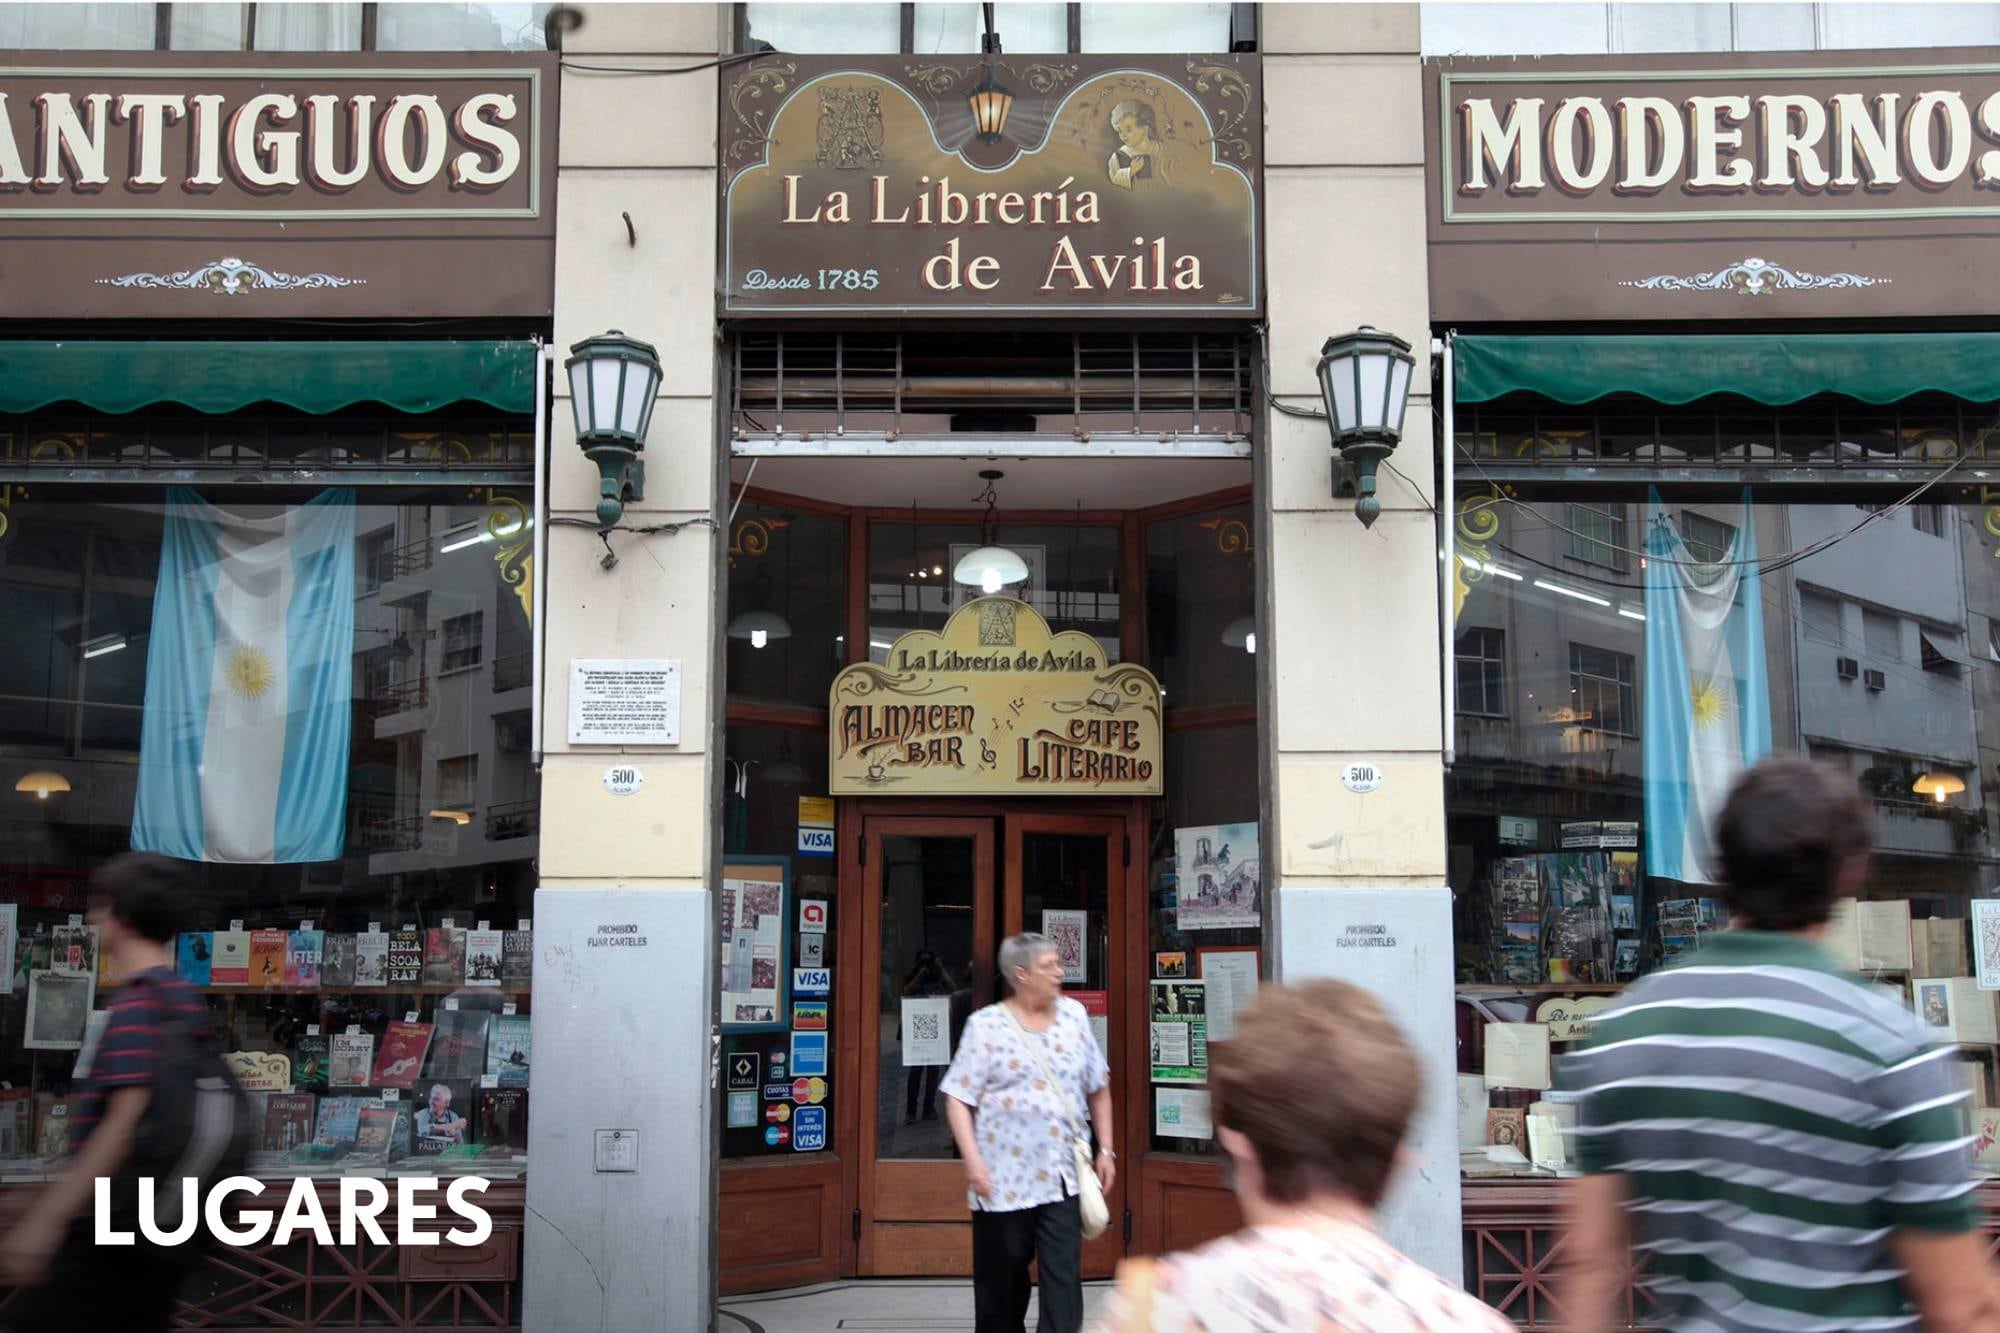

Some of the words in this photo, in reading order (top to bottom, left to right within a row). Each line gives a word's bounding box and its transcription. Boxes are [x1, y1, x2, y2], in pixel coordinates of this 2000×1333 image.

[780, 174, 851, 225] La
[871, 174, 1101, 225] Librería
[922, 236, 1001, 293] de
[1040, 235, 1205, 292] Avila
[741, 268, 812, 291] Desde
[816, 268, 880, 291] 1785
[898, 650, 926, 672] La
[928, 650, 1010, 672] Librería
[1015, 650, 1038, 671] de
[839, 704, 975, 757] ALMACEN
[1040, 718, 1141, 752] CAFE
[890, 736, 966, 767] BAR
[1016, 737, 1153, 785] LITERARIO
[612, 769, 635, 784] 500
[1350, 767, 1374, 781] 500
[802, 832, 832, 847] VISA
[597, 924, 638, 935] PROHIBIDO
[390, 940, 422, 952] BELA
[609, 936, 648, 947] CARTELES
[1358, 936, 1397, 948] CARTELES
[285, 950, 322, 964] AFTER
[808, 945, 820, 955] IC
[389, 955, 421, 966] SCOA
[391, 969, 418, 980] RAN
[798, 971, 828, 986] VISA
[797, 1135, 823, 1147] VISA
